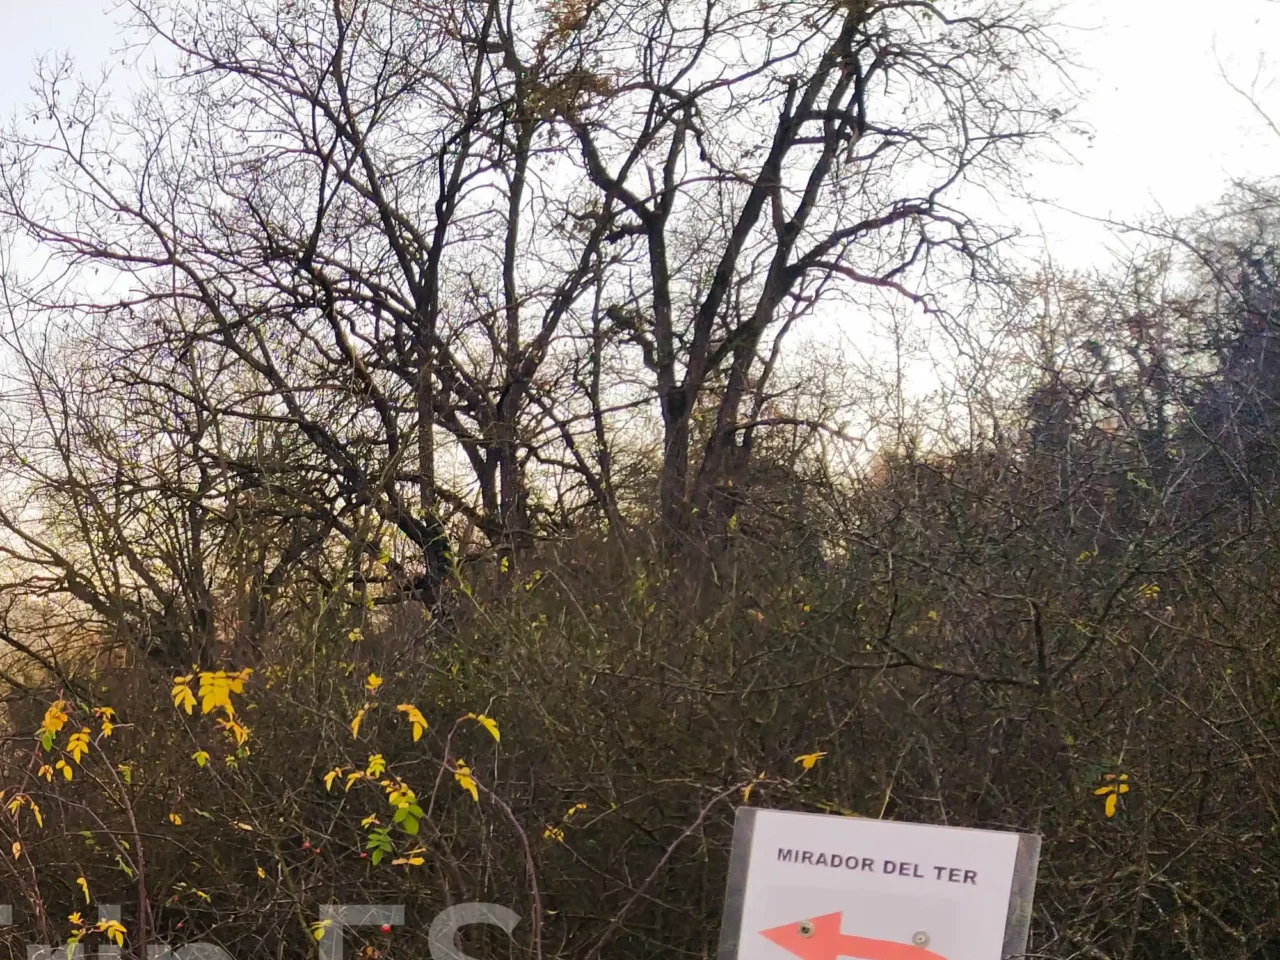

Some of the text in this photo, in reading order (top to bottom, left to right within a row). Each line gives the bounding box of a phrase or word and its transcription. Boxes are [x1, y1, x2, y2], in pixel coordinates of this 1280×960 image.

[777, 847, 978, 885] MIRADOR DEL TER
